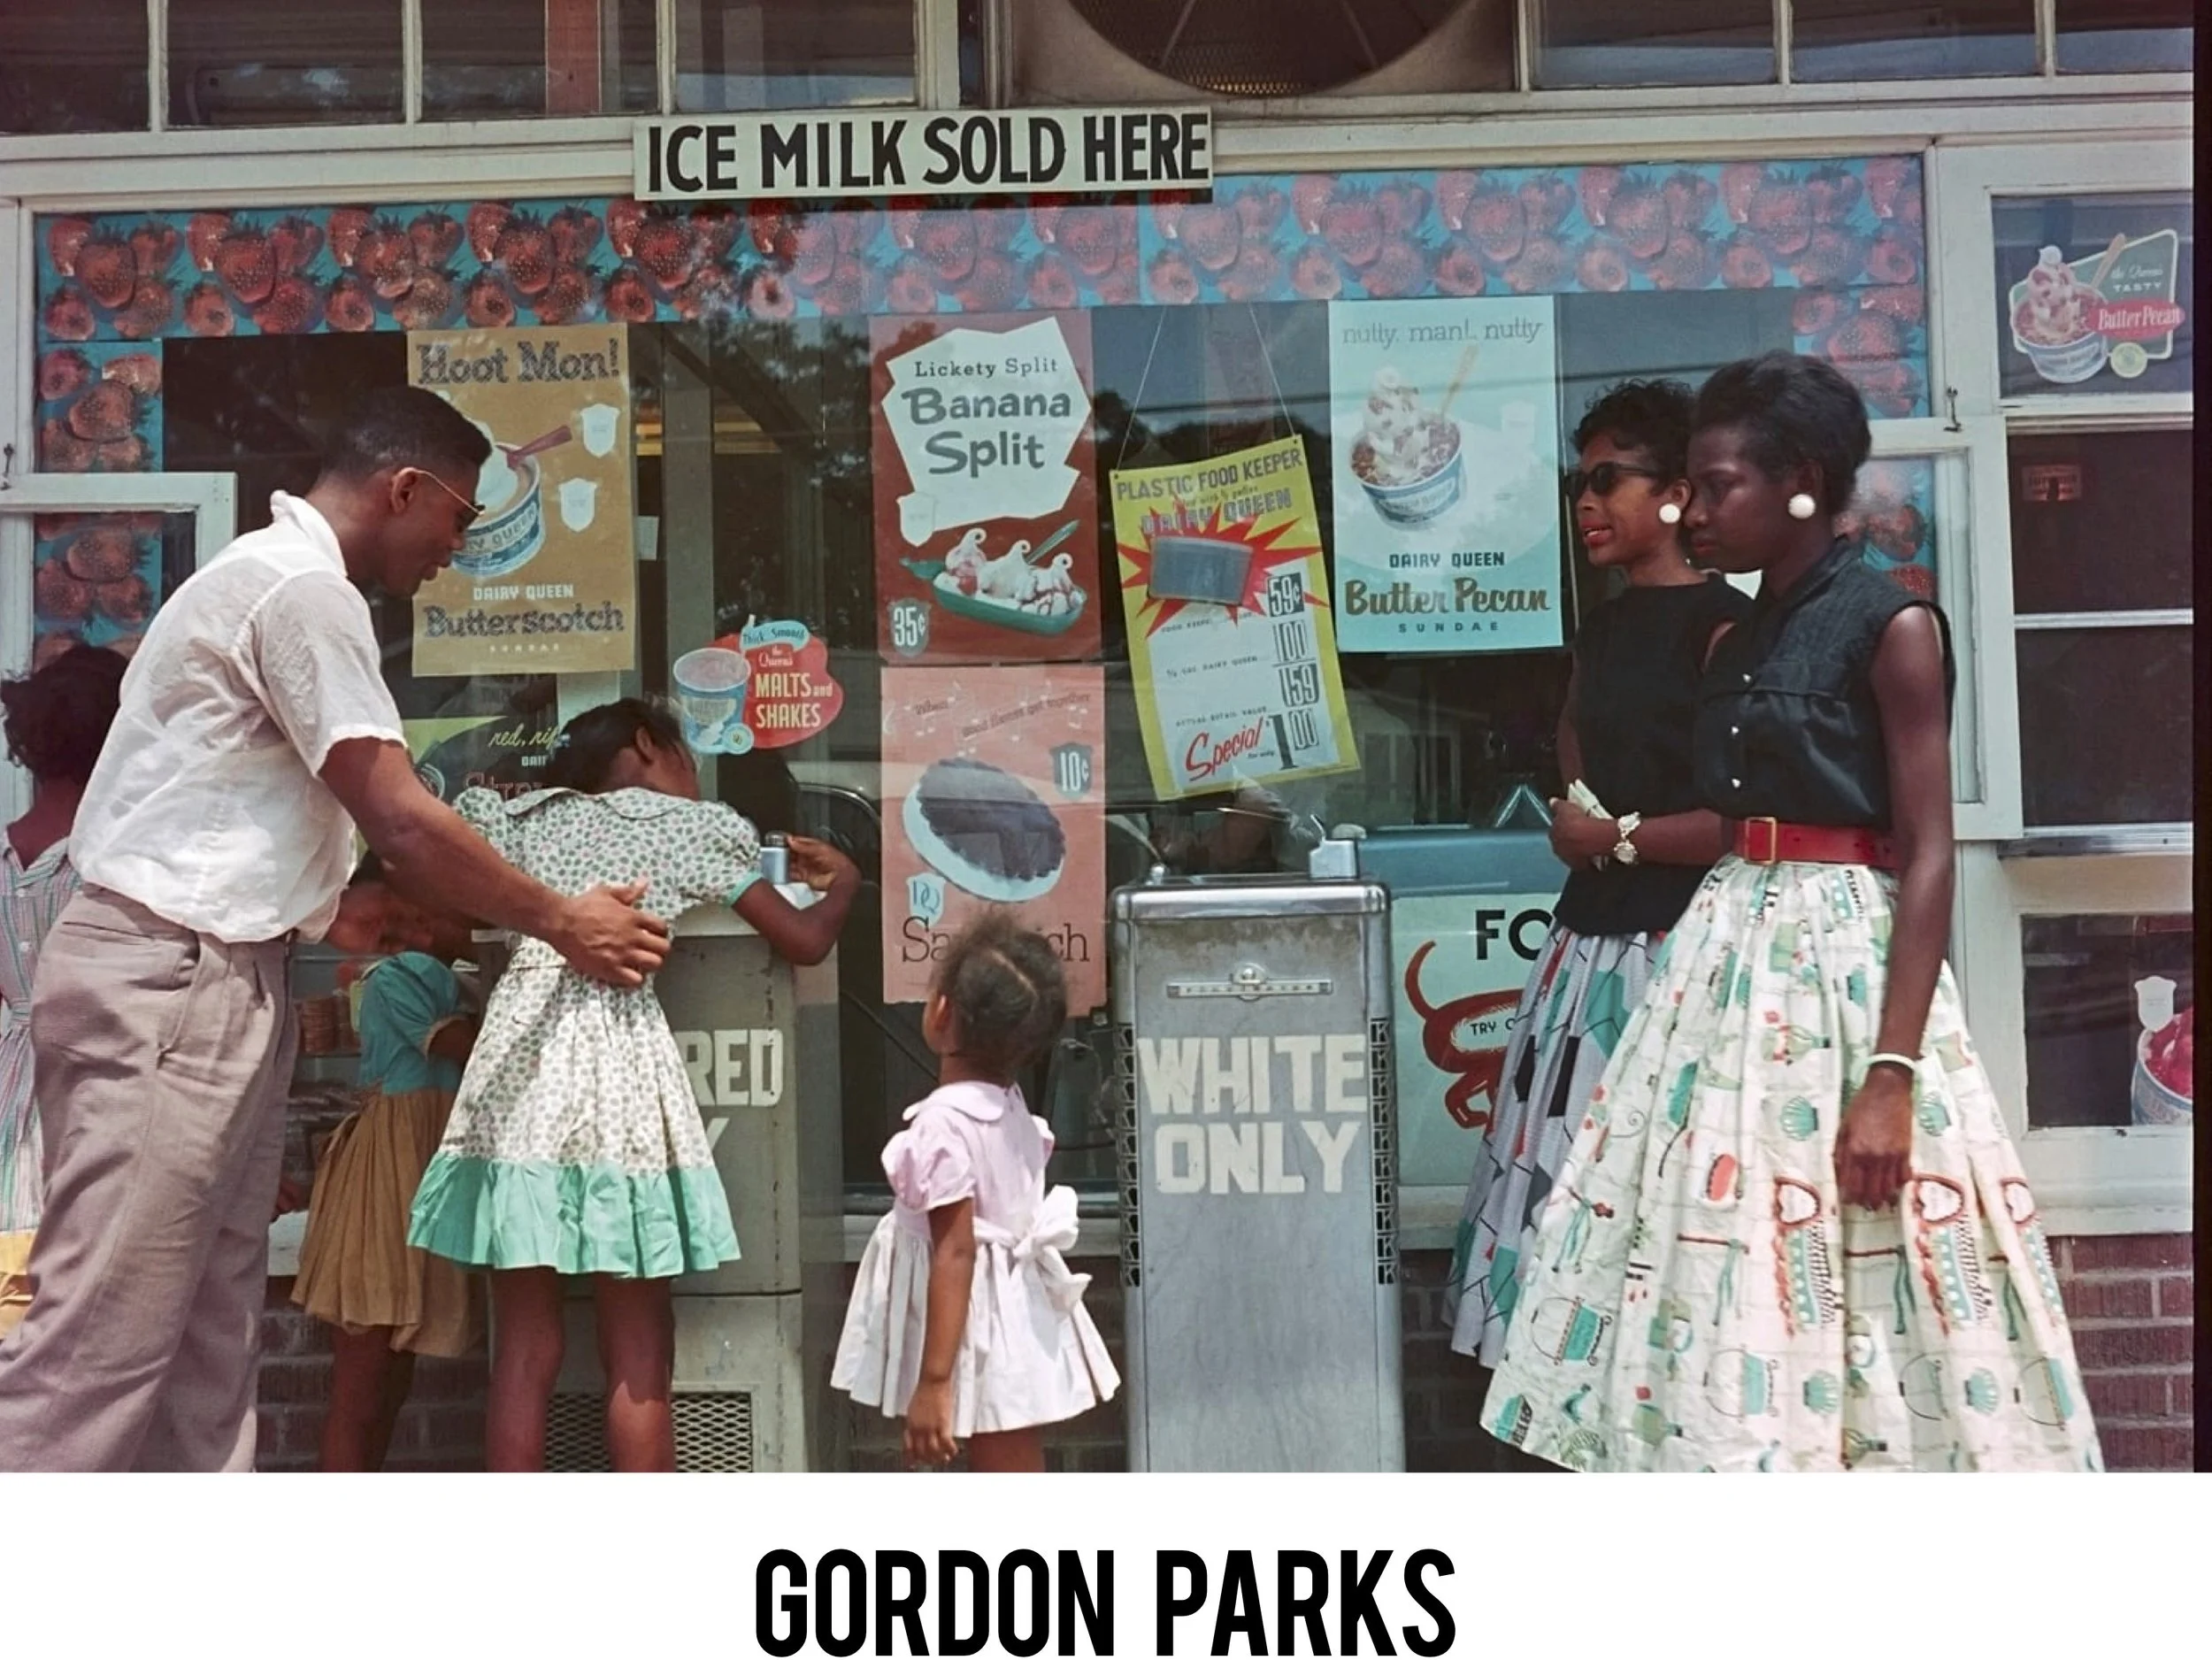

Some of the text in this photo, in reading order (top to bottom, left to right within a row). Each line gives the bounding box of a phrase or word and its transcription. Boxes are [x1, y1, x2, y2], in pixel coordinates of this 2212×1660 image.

[648, 112, 1210, 192] ICE MILK SOLD HERE
[2113, 281, 2162, 293] TASTY
[1485, 316, 1544, 343] nutty
[2098, 304, 2180, 331] Butter Pecan
[417, 337, 619, 383] Hoot Mon!
[914, 357, 1058, 379] Lickety Split
[901, 388, 1071, 426] Banana
[925, 431, 1045, 478] Split
[1117, 448, 1303, 501] PLASTIC FOOD KEEPER
[1141, 488, 1293, 534] DAIRY QUEEN
[1389, 551, 1505, 568] DAIRY QUEEN
[472, 584, 574, 602] DAIRY QUEEN
[1268, 573, 1301, 617] 59¢
[1344, 576, 1551, 616] Butter Pecan
[423, 601, 624, 637] Butterscotch
[892, 606, 926, 646] 35¢
[1398, 622, 1499, 633] SUNDAE
[756, 672, 833, 698] MALTS and
[1279, 664, 1319, 708] 159
[756, 703, 821, 728] SHAKES
[488, 723, 526, 748] red,
[1185, 715, 1264, 781] Special
[1061, 752, 1089, 792] 10¢
[913, 880, 941, 914] DQ
[1470, 1021, 1496, 1036] TRY
[1137, 1034, 1368, 1115] WHITE
[1155, 1120, 1362, 1195] ONLY
